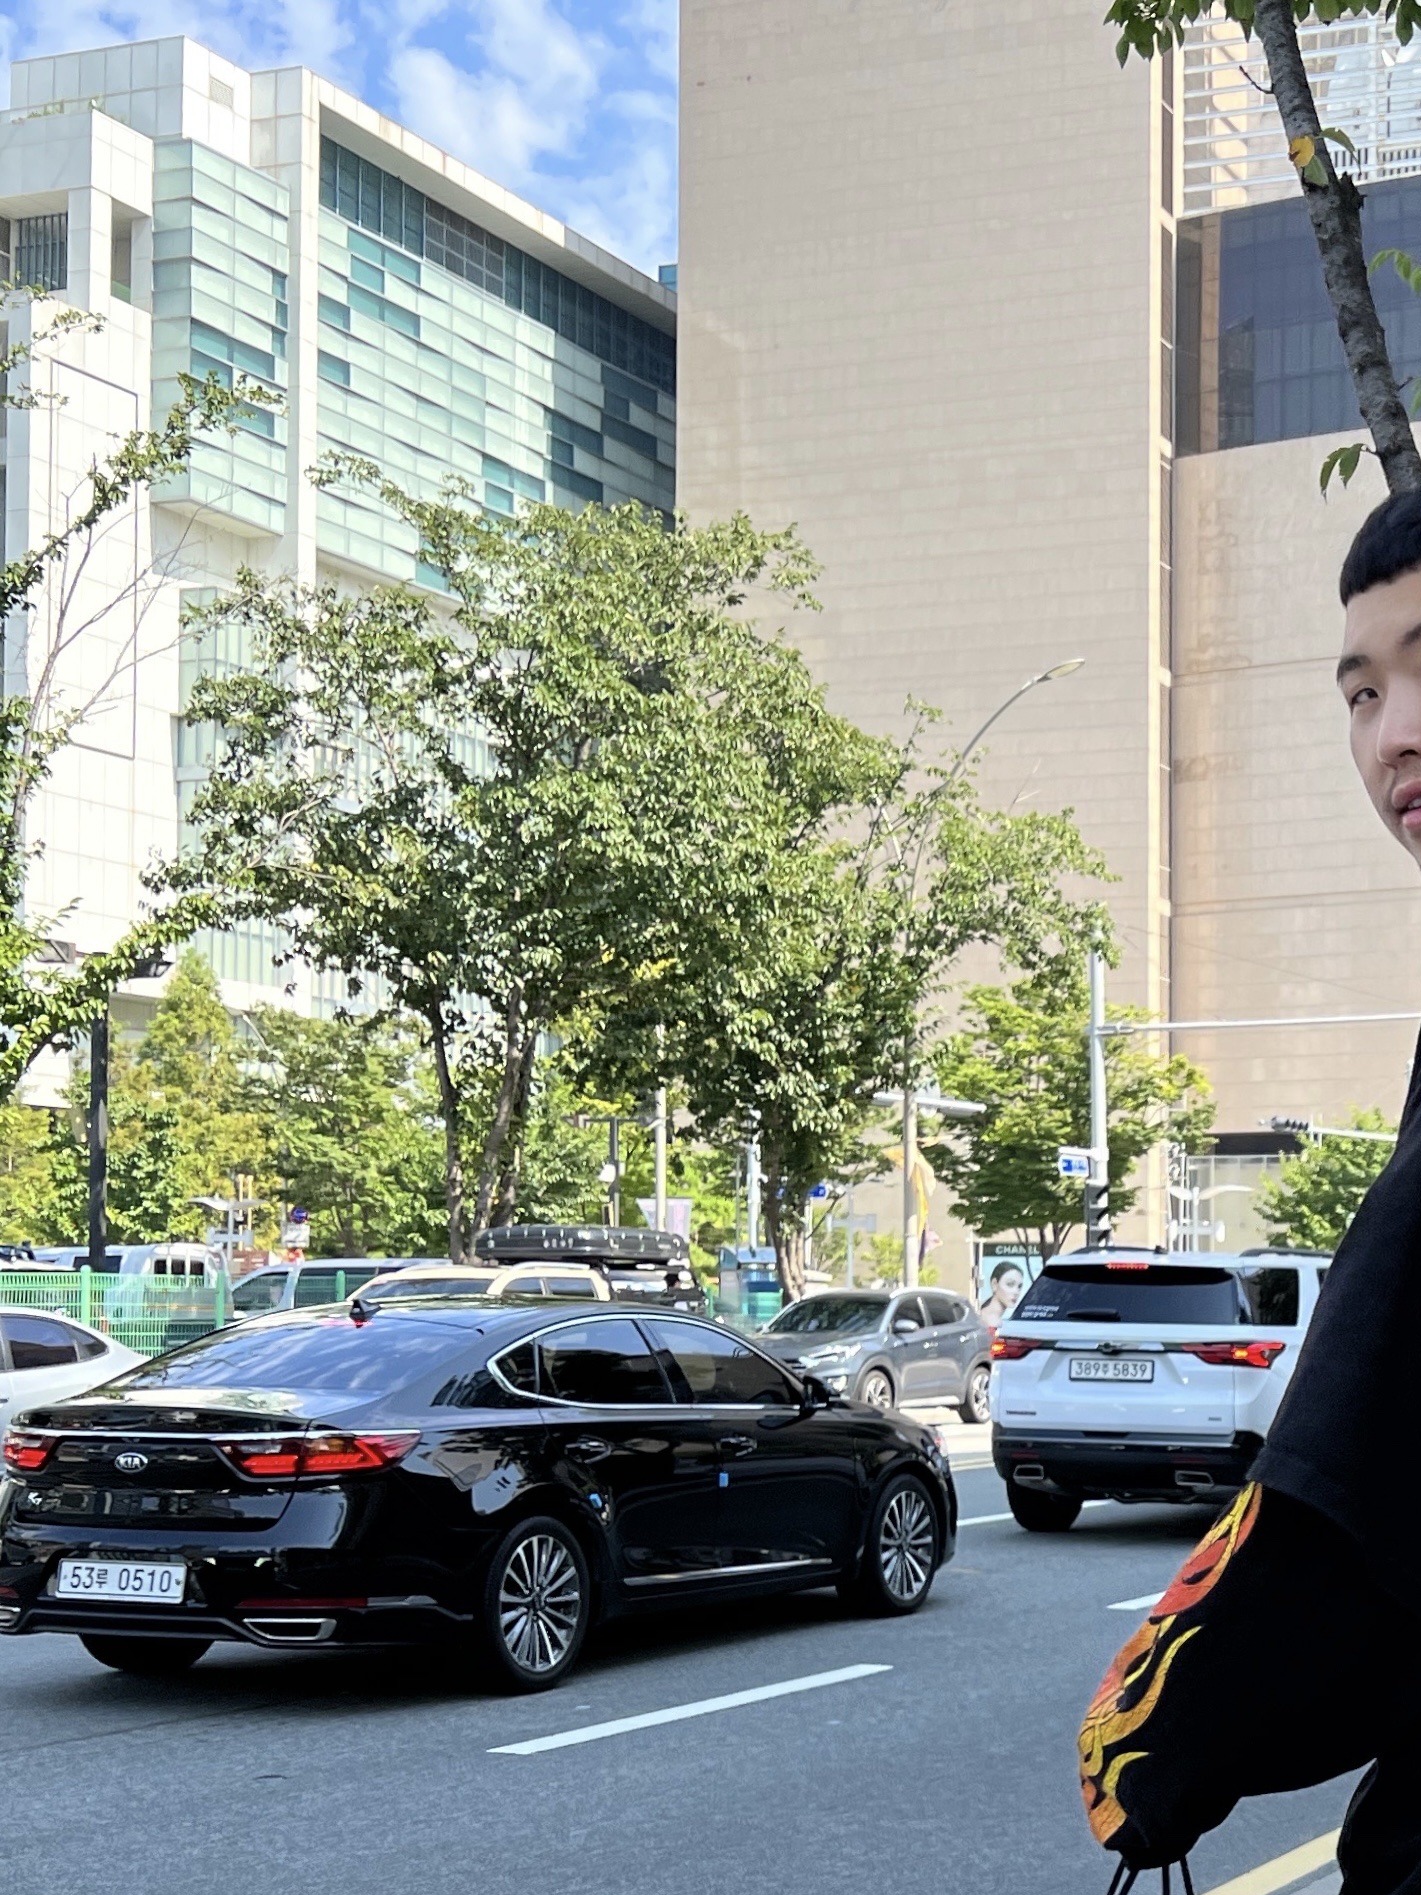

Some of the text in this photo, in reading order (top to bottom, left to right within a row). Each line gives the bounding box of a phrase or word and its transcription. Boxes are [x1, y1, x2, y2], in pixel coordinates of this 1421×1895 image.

[1112, 1363, 1148, 1378] 5839
[118, 1455, 142, 1469] KIA
[69, 1566, 172, 1593] 53루 0510
